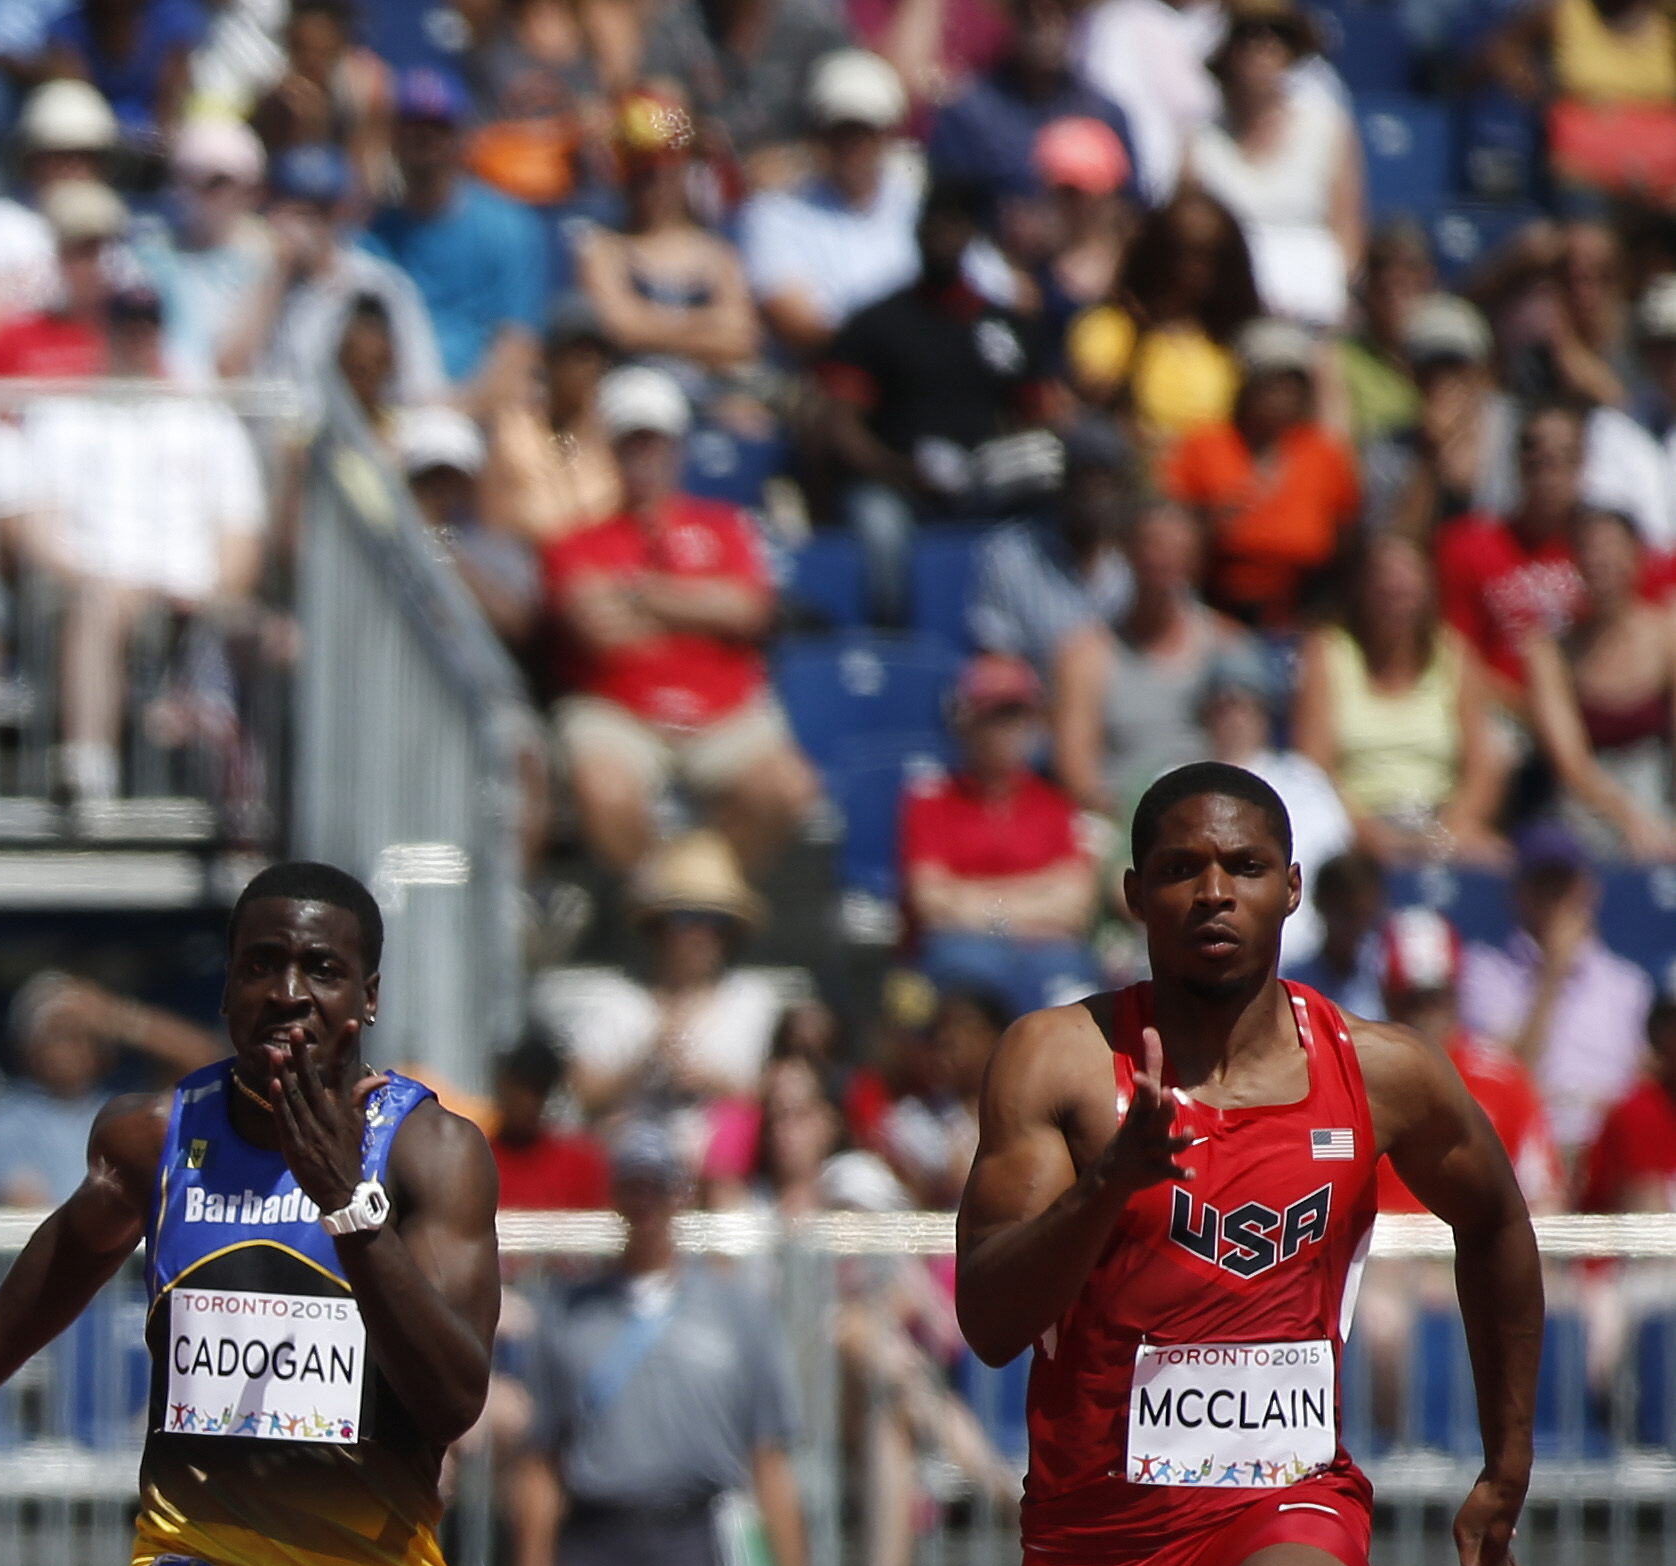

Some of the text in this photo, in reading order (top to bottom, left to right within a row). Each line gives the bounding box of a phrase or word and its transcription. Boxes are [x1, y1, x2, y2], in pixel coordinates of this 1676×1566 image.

[184, 1186, 321, 1225] Barbado
[1169, 1182, 1333, 1280] USA
[183, 1294, 348, 1320] TORONTO 2015
[174, 1335, 355, 1385] CADOGAN
[1155, 1346, 1321, 1366] TORONTO 2015
[1138, 1386, 1326, 1429] MCCLAIN
